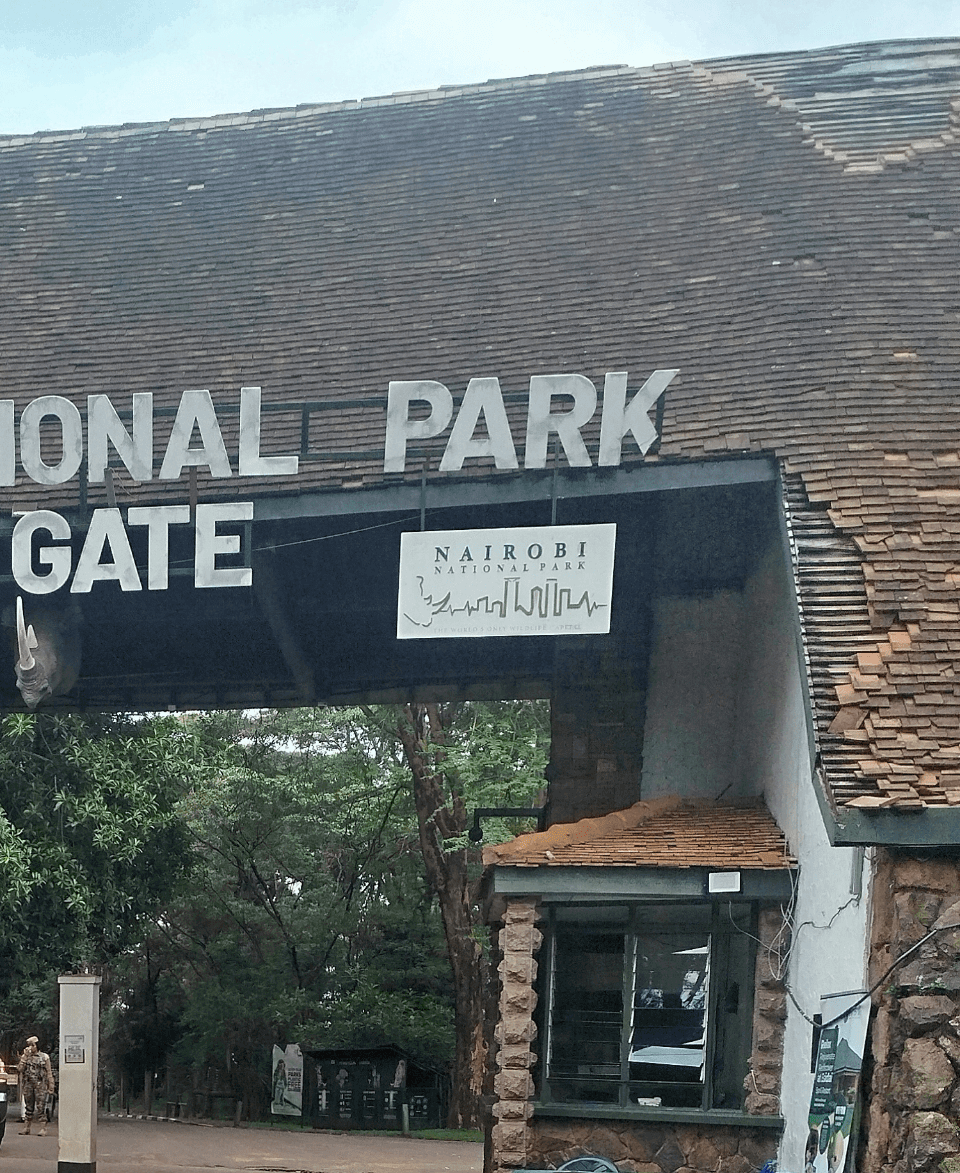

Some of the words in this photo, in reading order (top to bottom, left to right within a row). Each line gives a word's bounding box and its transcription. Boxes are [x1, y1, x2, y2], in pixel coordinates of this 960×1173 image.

[384, 369, 680, 473] PARK
[12, 502, 254, 594] GATE
[434, 541, 586, 562] NAIROBI
[434, 563, 530, 574] NATIONAL
[540, 561, 586, 572] PARK
